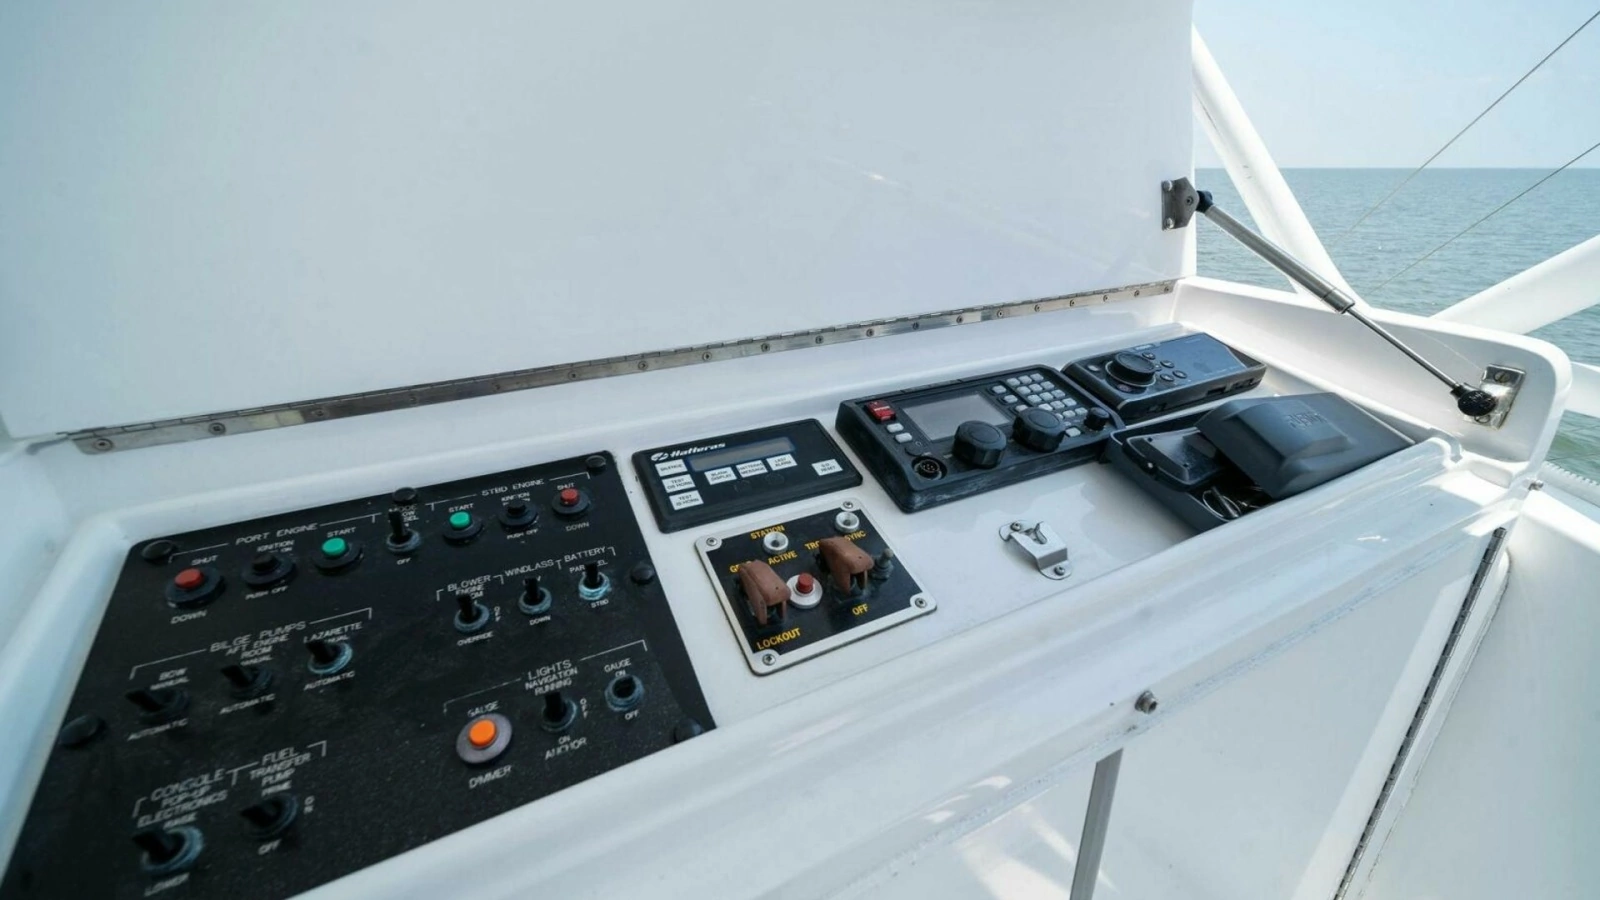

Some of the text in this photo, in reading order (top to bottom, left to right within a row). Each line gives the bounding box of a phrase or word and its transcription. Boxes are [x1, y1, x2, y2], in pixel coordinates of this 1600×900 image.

[670, 443, 726, 458] Hatteras
[481, 479, 545, 497] STBD ENGINE
[448, 503, 474, 514] START
[235, 523, 319, 545] PORT ENGINE
[326, 527, 357, 538] START
[565, 522, 590, 532] DOWN
[750, 525, 785, 540] STATION
[190, 554, 218, 566] SHUT
[563, 546, 606, 563] BATTERY
[768, 550, 798, 565] ACTIVE
[504, 559, 554, 577] WINDLASS
[447, 574, 491, 592] BLOWER
[170, 610, 208, 624] DOWN
[852, 603, 869, 616] OFF
[529, 615, 551, 626] DOWN
[209, 620, 306, 653] BILGE PUMPS
[303, 621, 363, 643] LAZARETTE
[756, 628, 801, 650] LOCKOUT
[241, 645, 272, 660] ROOM
[158, 667, 188, 681] BOW
[527, 659, 573, 682] LIGHTS
[604, 658, 632, 673] GAUGE
[304, 671, 355, 691] AUTOMATIC
[525, 668, 579, 691] NAVIGATION
[534, 679, 573, 696] RUNNING
[219, 693, 276, 715] AUTOMATIC
[467, 700, 500, 717] GAUGE
[624, 709, 640, 721] OFF
[127, 718, 189, 742] AUTOMATIC
[262, 746, 299, 767] FUEL
[544, 737, 587, 760] ANCHOR
[249, 752, 312, 780] TRANSFER
[150, 768, 226, 802] CONSOLE
[261, 768, 296, 787] PUMP
[468, 765, 513, 789] DIMMER
[137, 789, 229, 829] ELECTRONICS
